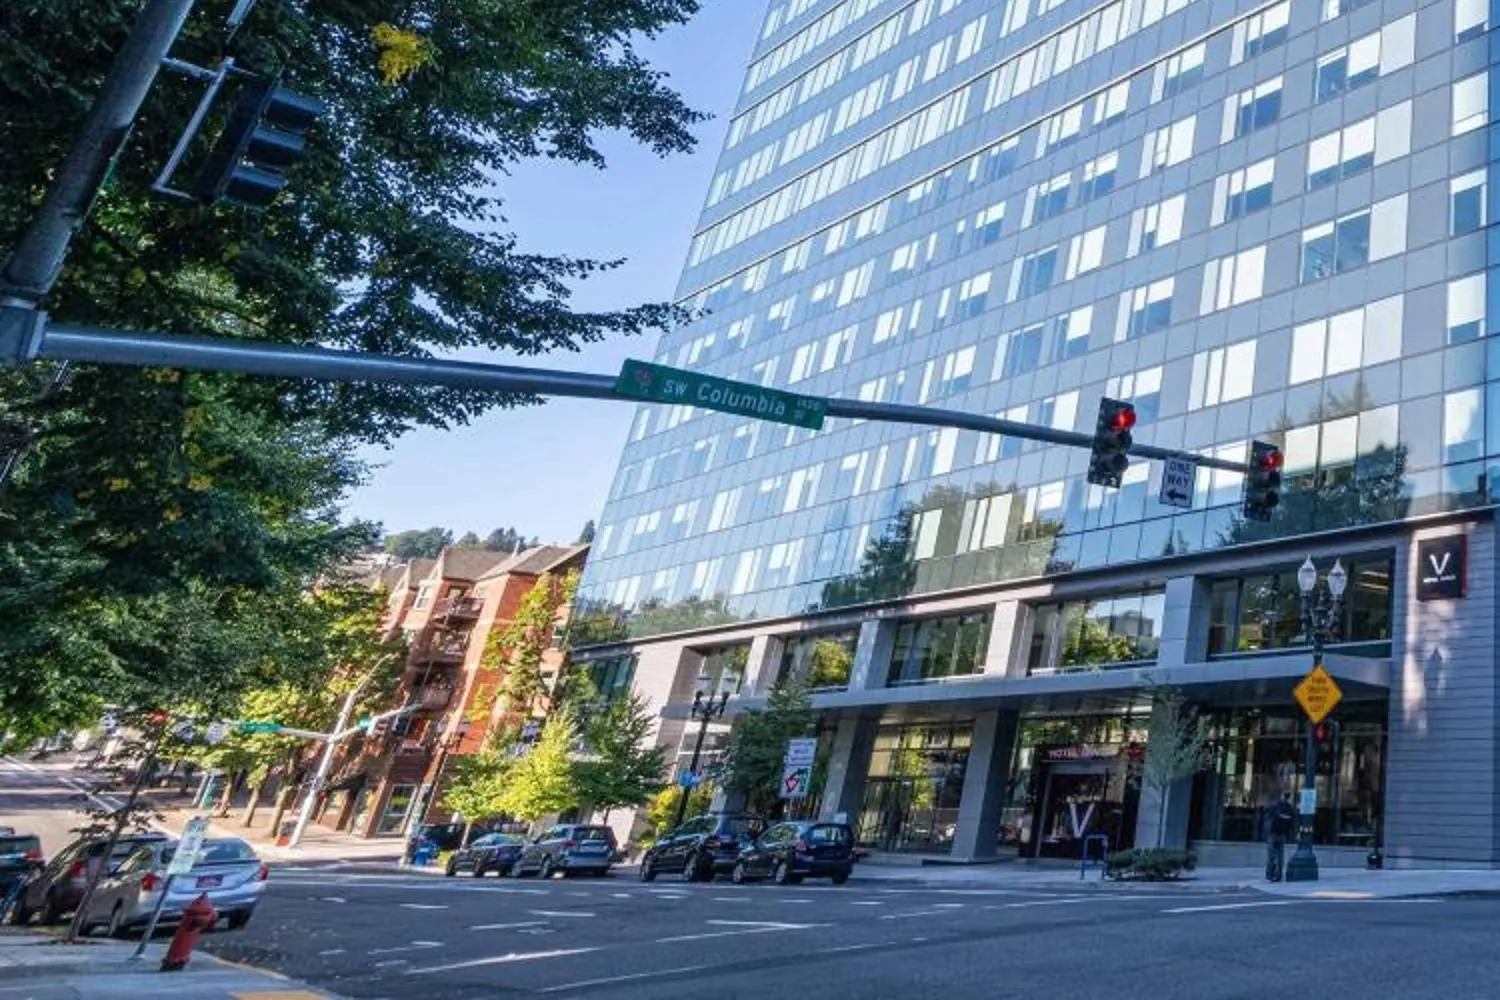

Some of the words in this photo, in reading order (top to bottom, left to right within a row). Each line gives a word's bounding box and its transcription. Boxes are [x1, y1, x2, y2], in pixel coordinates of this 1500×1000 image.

[664, 379, 688, 396] SW
[697, 383, 785, 416] Columbia
[1170, 460, 1191, 474] ONE
[1167, 474, 1190, 489] WAY
[1429, 552, 1451, 575] V
[1069, 802, 1096, 838] V
